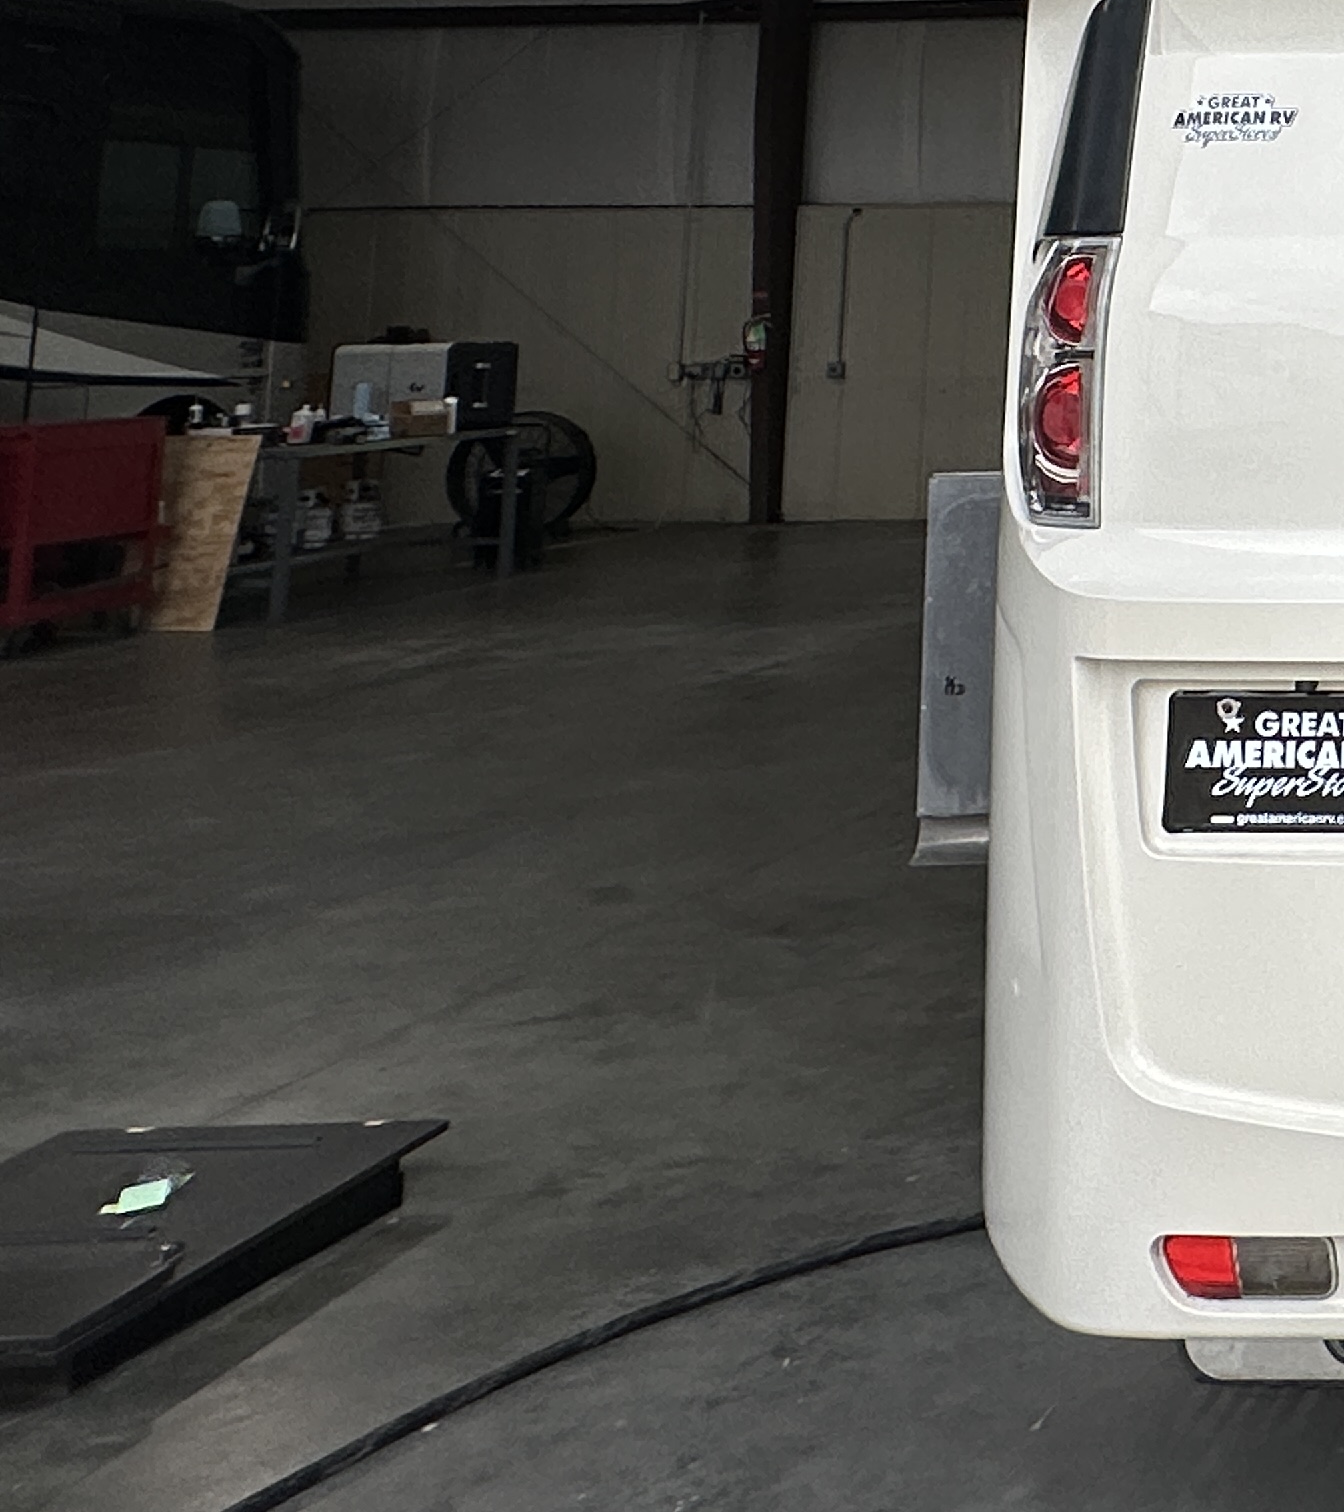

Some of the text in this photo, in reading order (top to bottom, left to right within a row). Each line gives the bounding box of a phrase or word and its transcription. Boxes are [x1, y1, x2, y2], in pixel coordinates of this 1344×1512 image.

[1207, 95, 1260, 109] GREAT
[1173, 110, 1296, 127] AMERICAN RV
